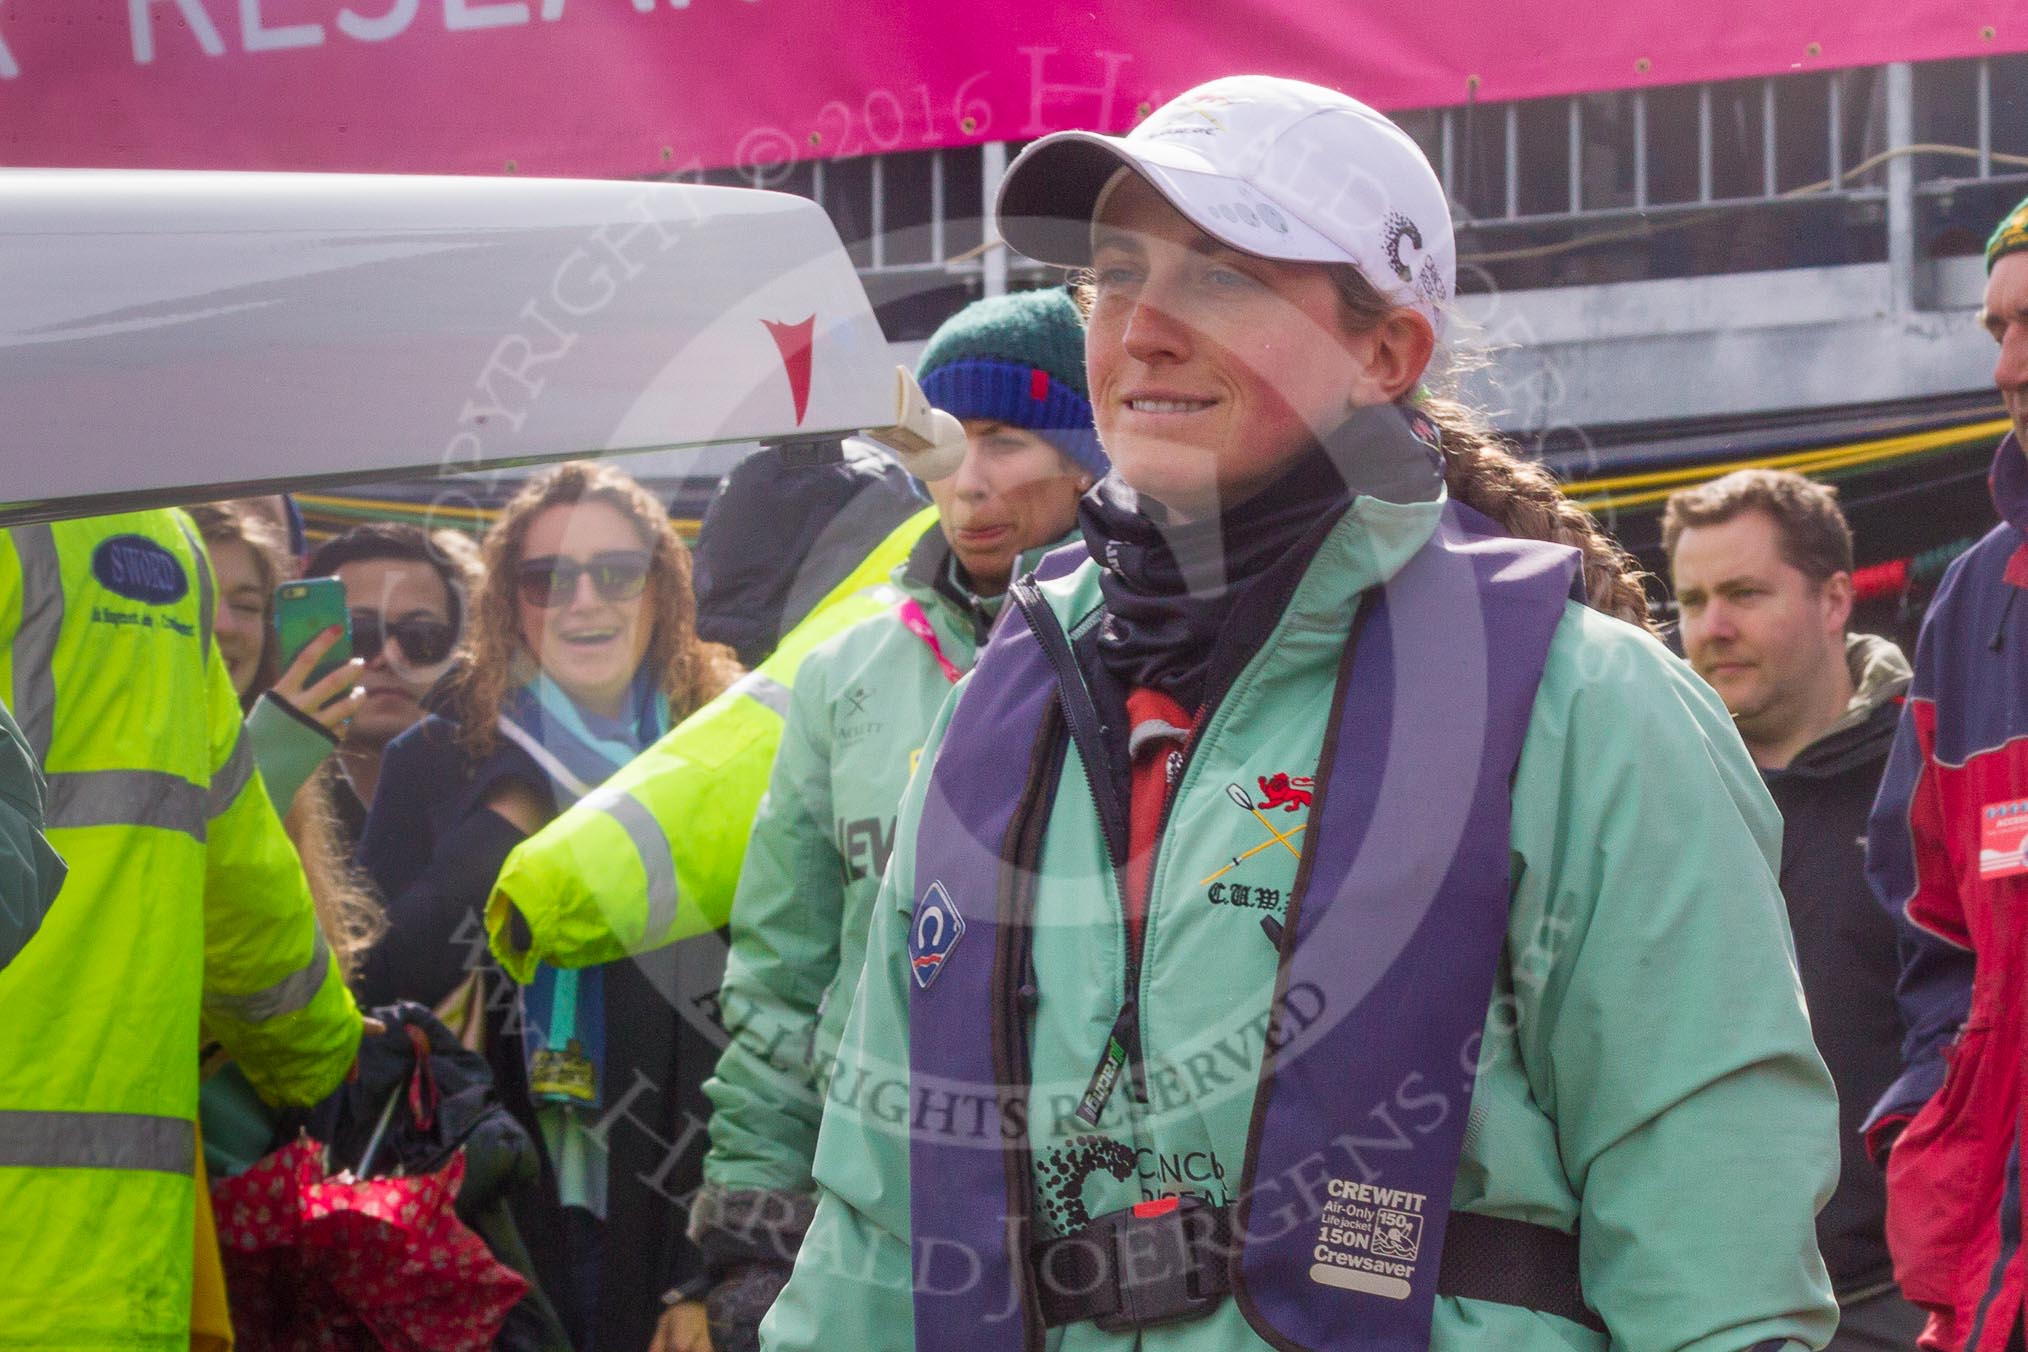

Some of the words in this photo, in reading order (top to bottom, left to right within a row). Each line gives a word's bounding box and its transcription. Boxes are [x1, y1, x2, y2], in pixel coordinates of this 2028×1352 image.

[1327, 1178, 1427, 1212] CREWFIT
[1323, 1200, 1376, 1222] Air-Only
[1379, 1211, 1408, 1228] 150
[1318, 1226, 1370, 1250] 150N
[1313, 1244, 1416, 1279] Crewsaver
